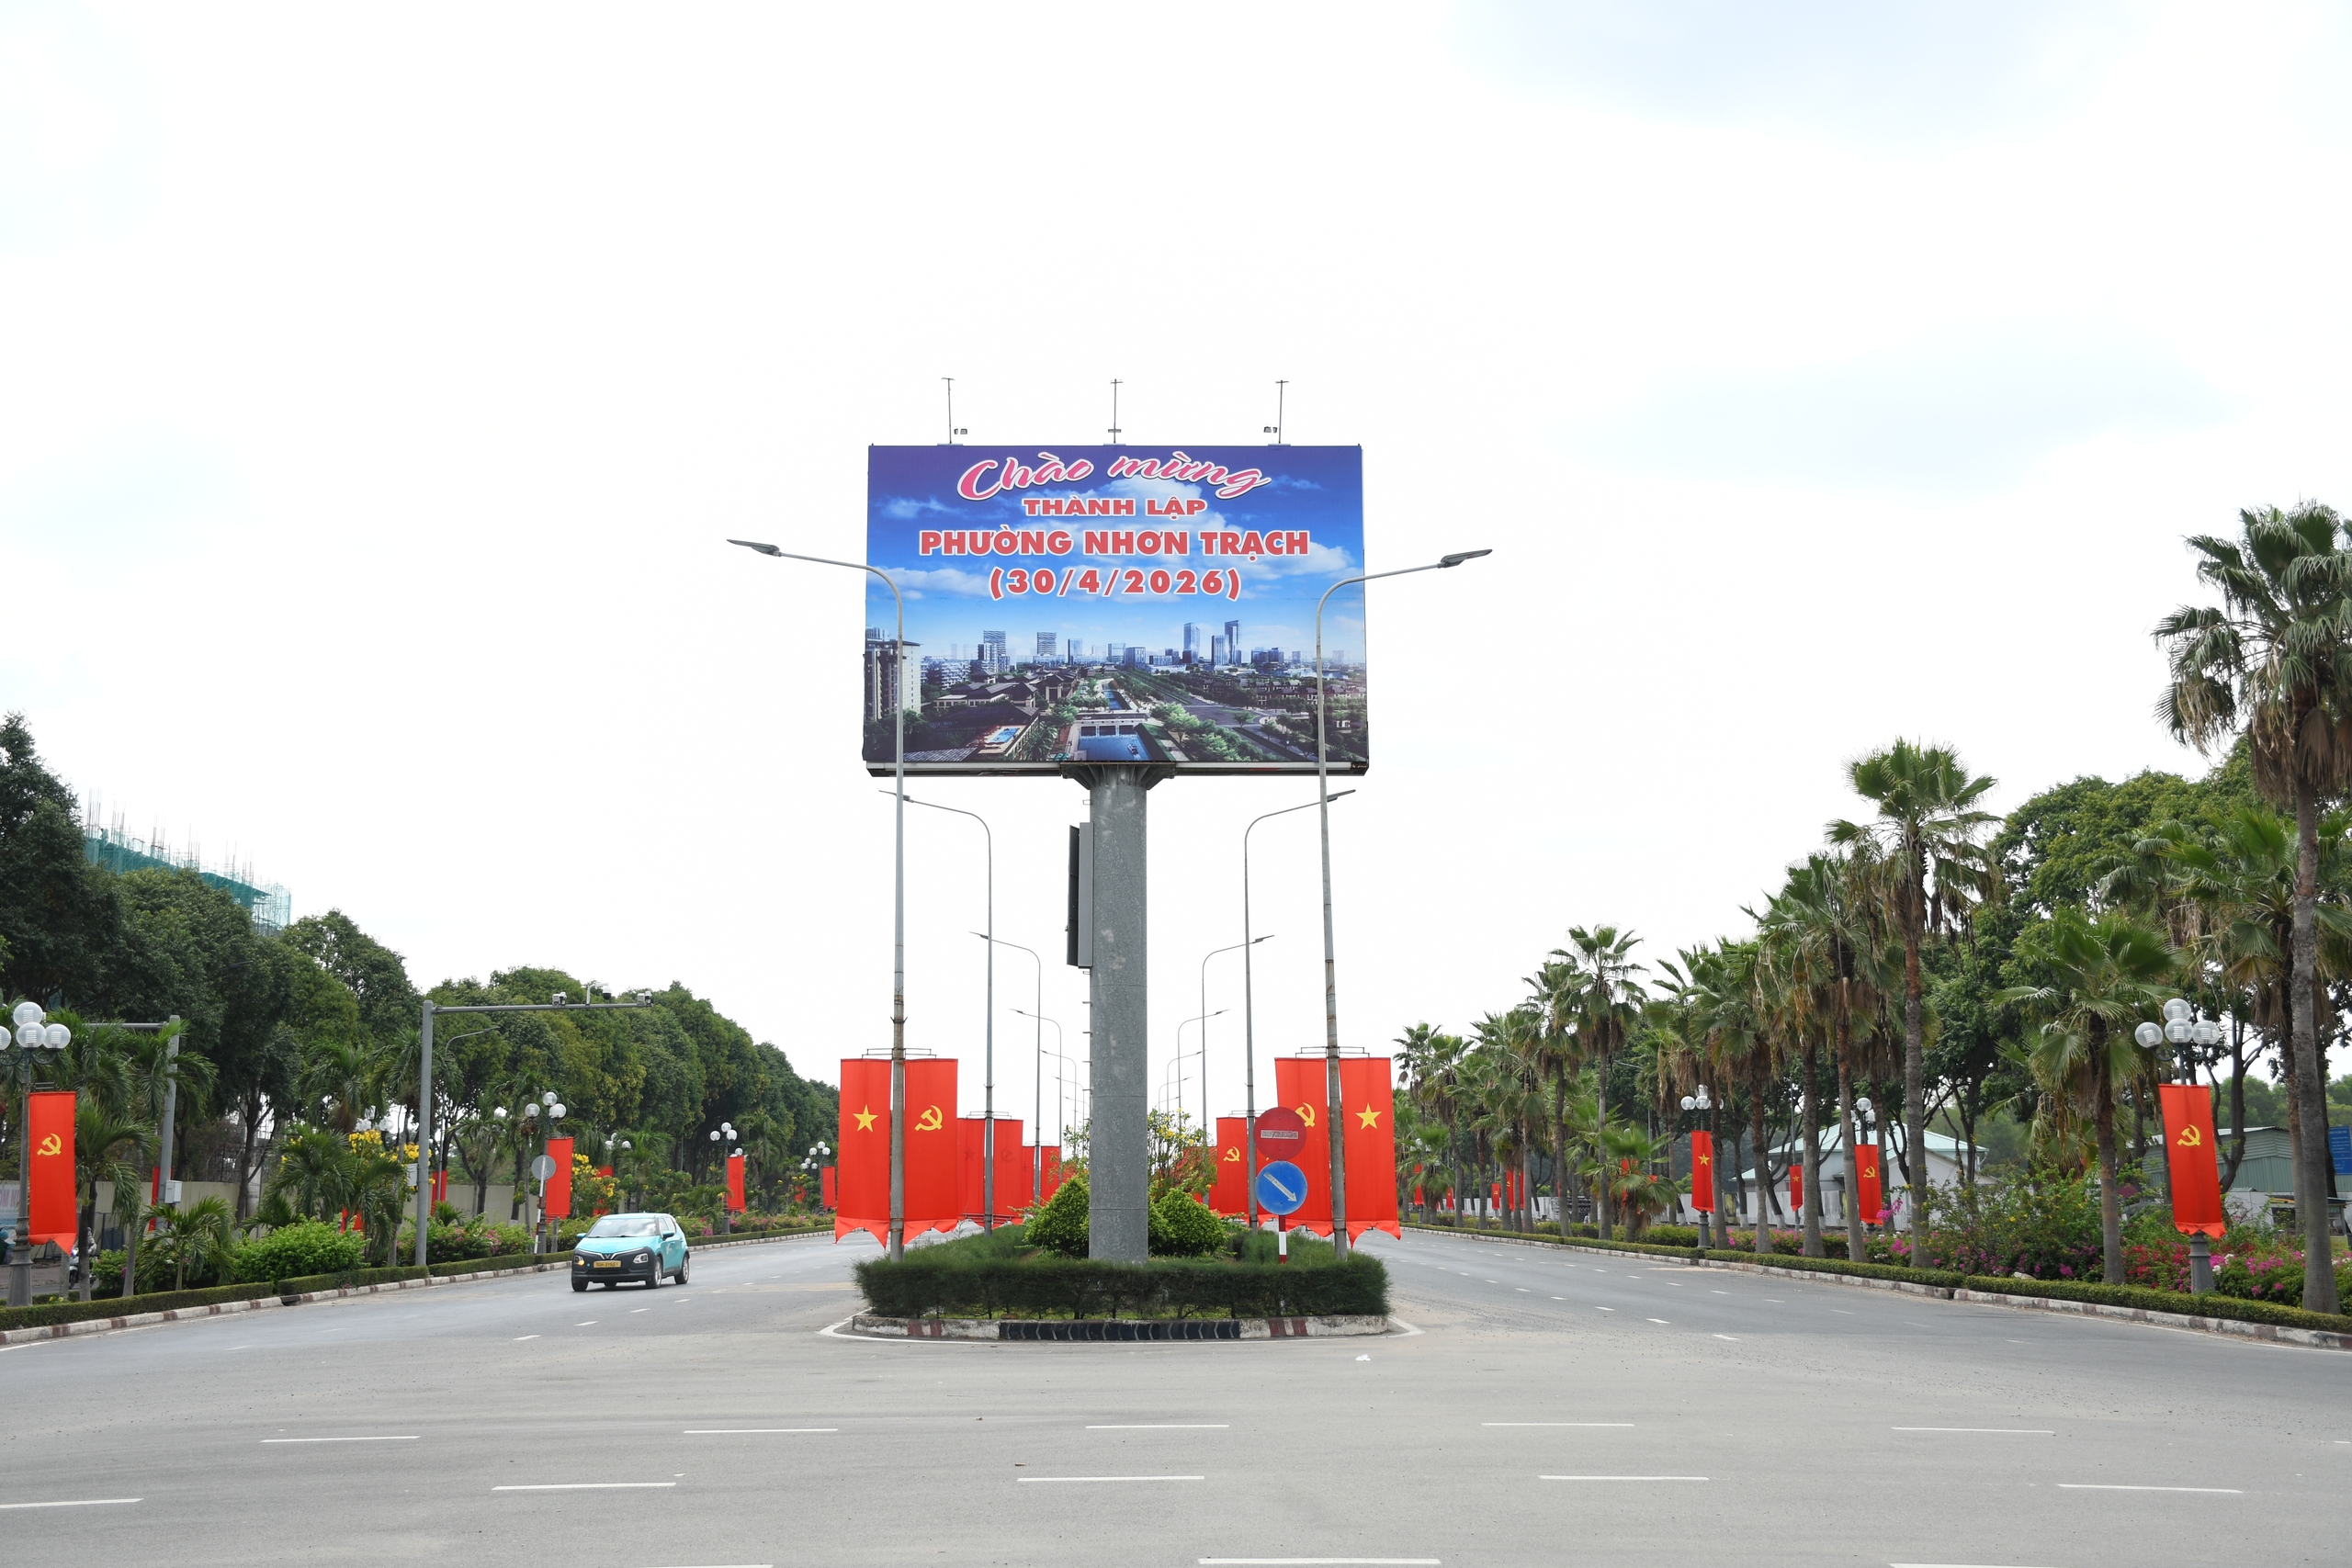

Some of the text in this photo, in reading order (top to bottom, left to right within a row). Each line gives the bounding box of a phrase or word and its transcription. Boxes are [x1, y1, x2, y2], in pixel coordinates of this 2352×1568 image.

[957, 451, 1272, 501] Chào mừng
[1023, 496, 1207, 520] THÀNH LẬP
[920, 525, 1309, 561] PHƯỜNG NHƠN TRẠCH
[989, 567, 1241, 601] (30/4/2026)
